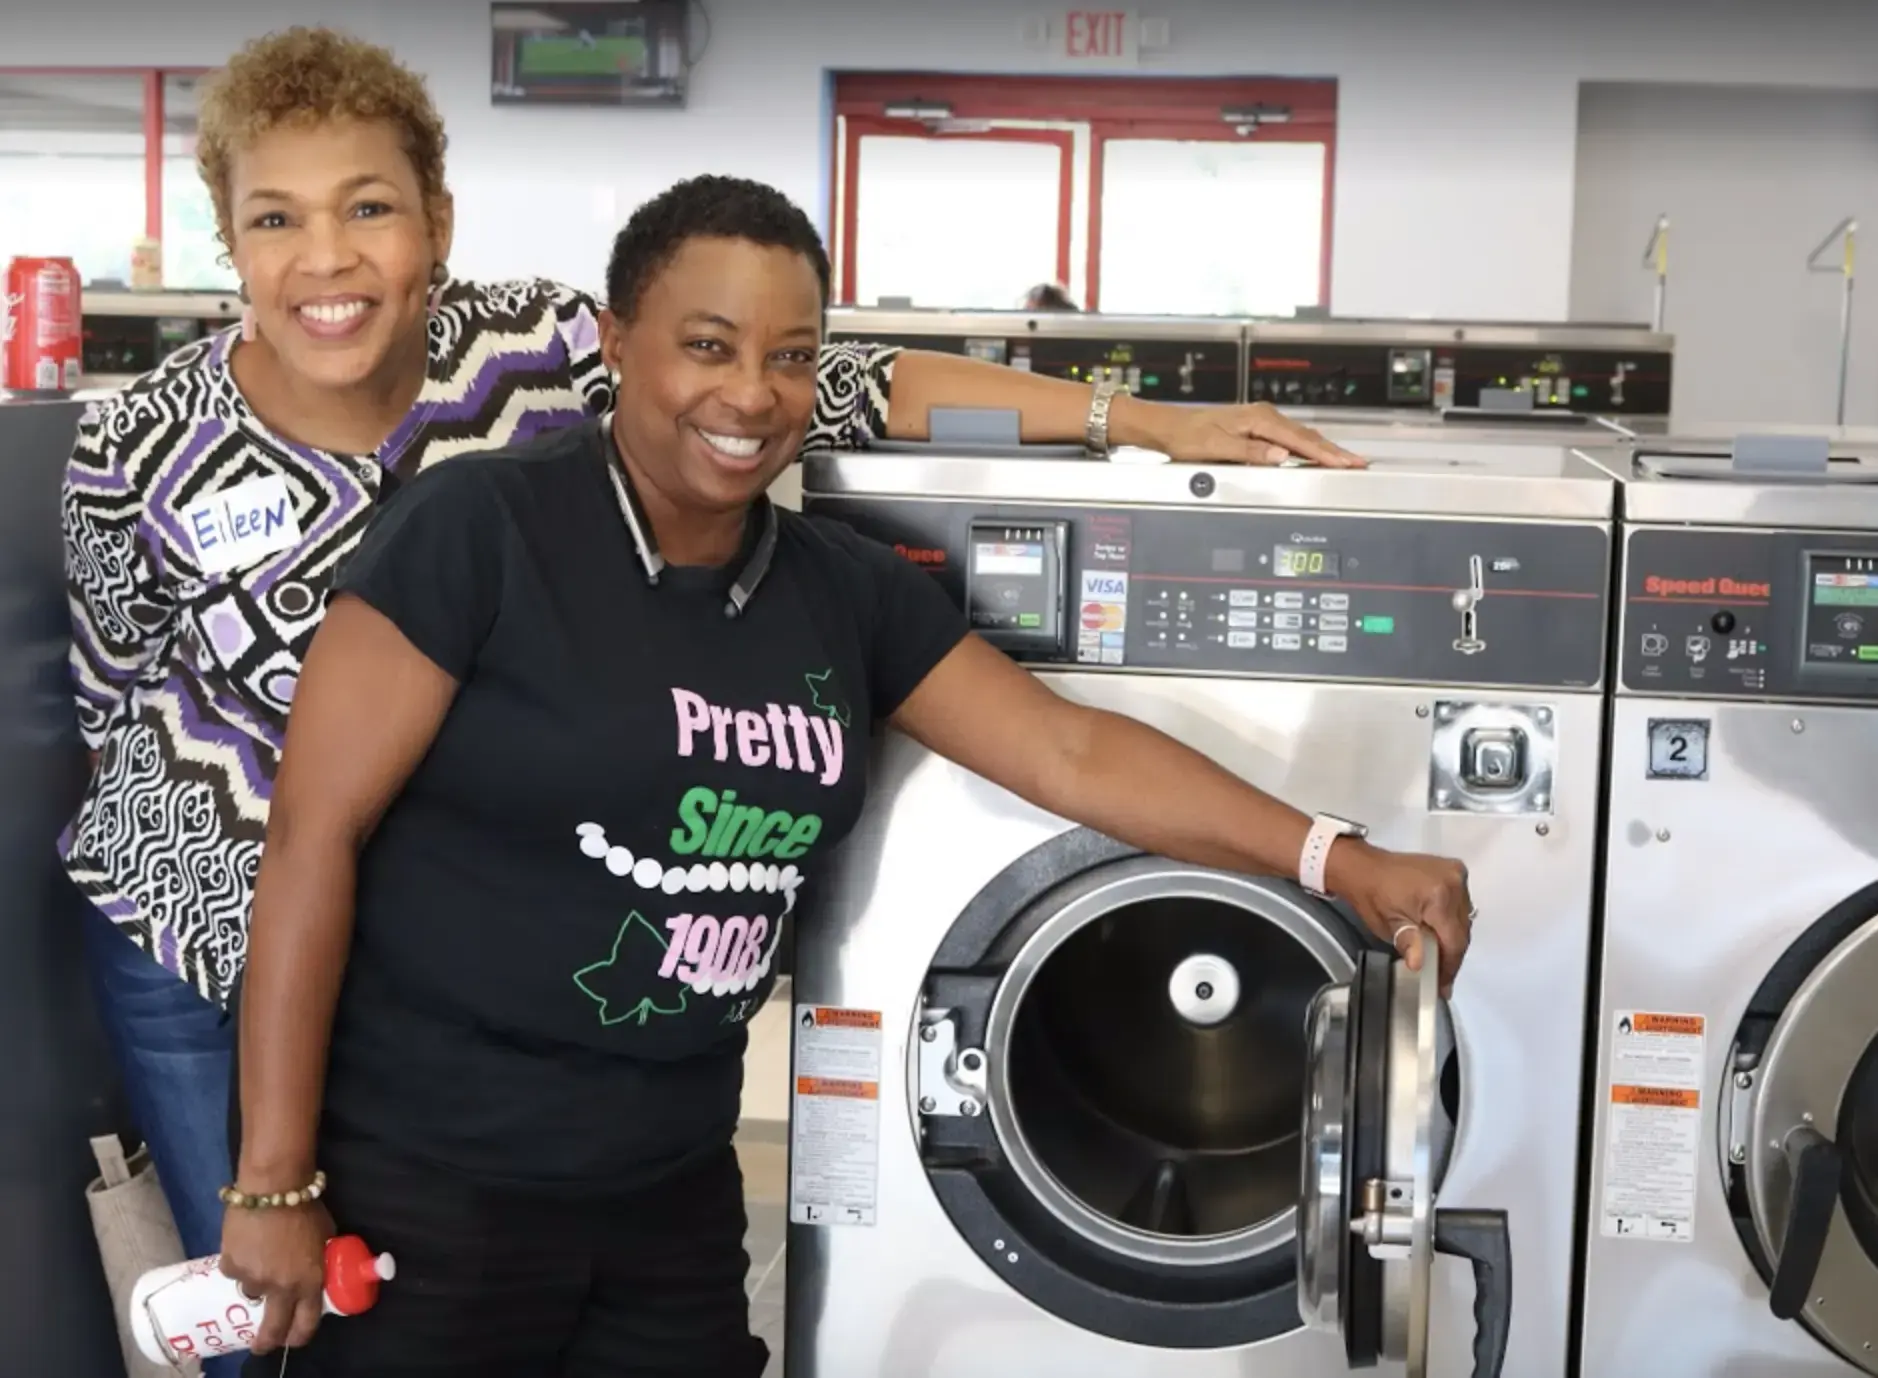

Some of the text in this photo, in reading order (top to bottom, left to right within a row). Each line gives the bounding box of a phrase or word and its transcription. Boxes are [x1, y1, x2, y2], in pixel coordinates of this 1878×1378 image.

[1066, 11, 1126, 57] EXIT
[1087, 578, 1125, 594] VISA
[1645, 576, 1715, 597] Speed
[670, 687, 844, 786] Pretty
[1669, 736, 1688, 761] 2
[670, 786, 823, 858] Since
[657, 913, 768, 985] 1908
